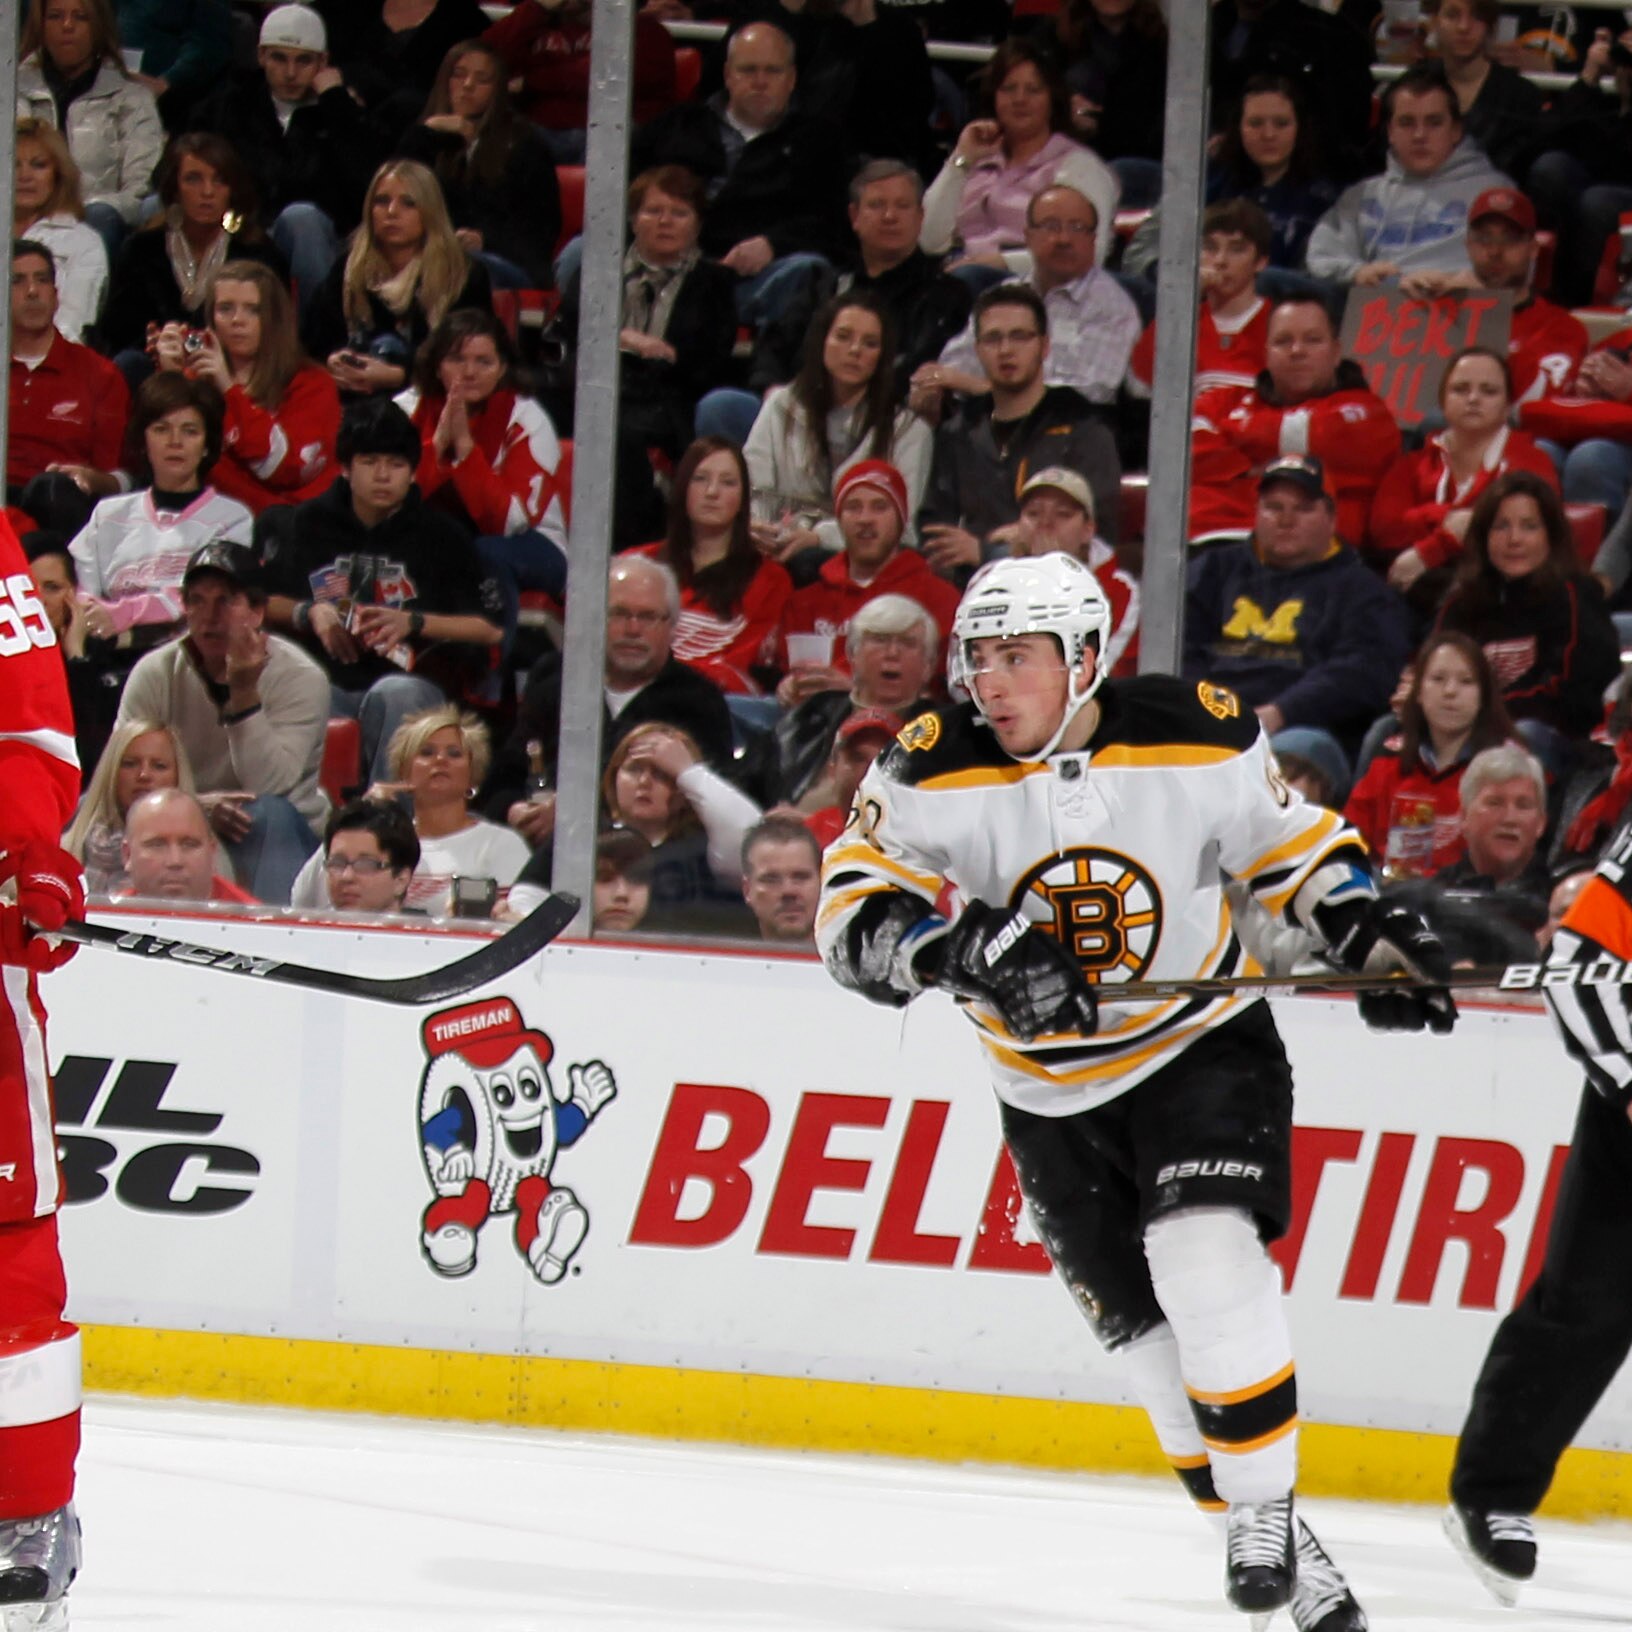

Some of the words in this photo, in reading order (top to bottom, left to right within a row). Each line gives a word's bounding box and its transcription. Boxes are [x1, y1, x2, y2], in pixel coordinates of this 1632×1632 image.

[1354, 296, 1498, 358] BERT
[1222, 596, 1304, 643] M
[432, 1007, 512, 1042] TIREMAN
[1156, 1159, 1264, 1187] BAUER
[1268, 1126, 1572, 1312] TIR
